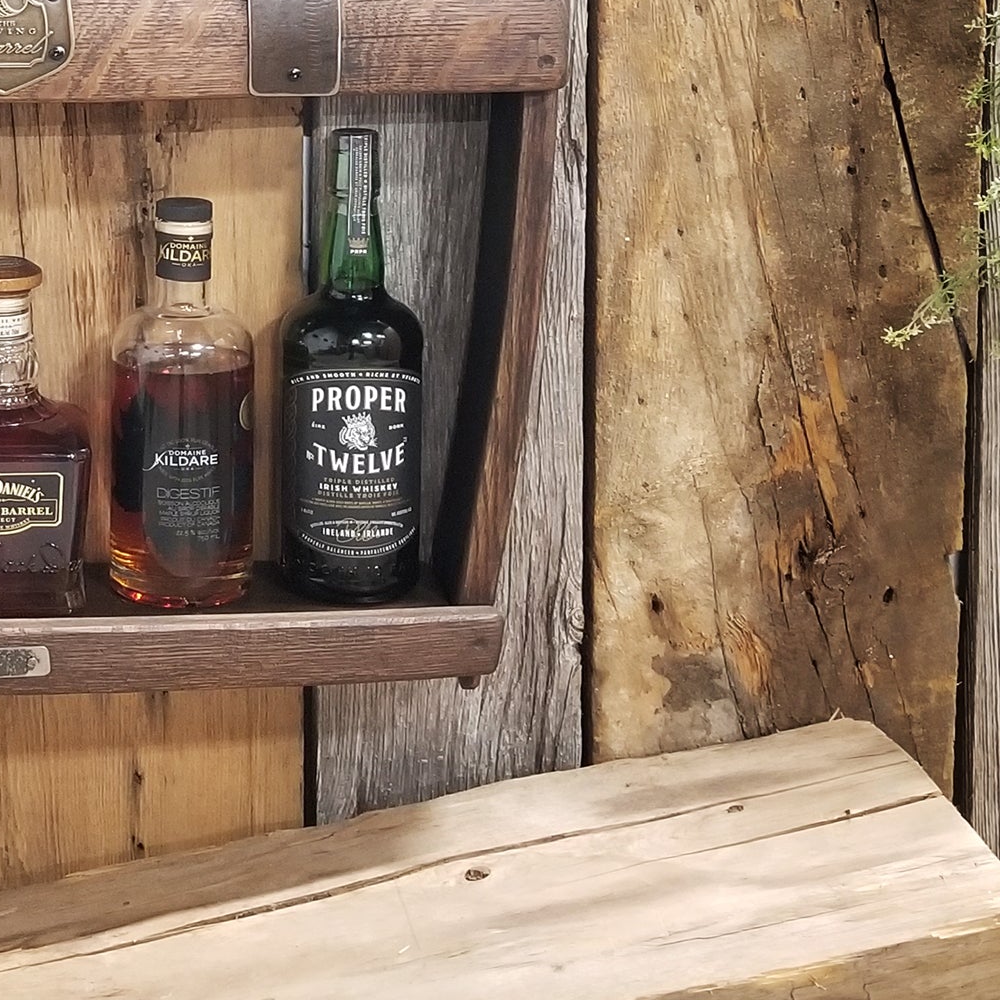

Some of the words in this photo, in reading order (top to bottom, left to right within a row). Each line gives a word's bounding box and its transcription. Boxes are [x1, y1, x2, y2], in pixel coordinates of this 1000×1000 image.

[311, 385, 406, 413] PROPER
[142, 450, 219, 472] KILDARE
[312, 442, 405, 475] TWELVE
[324, 477, 352, 485] TRIPLE
[355, 477, 396, 485] DISTILLED
[319, 483, 349, 493] IRISH
[353, 482, 399, 493] WHISKEY
[1, 506, 53, 517] BARREL
[322, 527, 354, 537] IRELAND
[362, 527, 394, 538] IRLANDE
